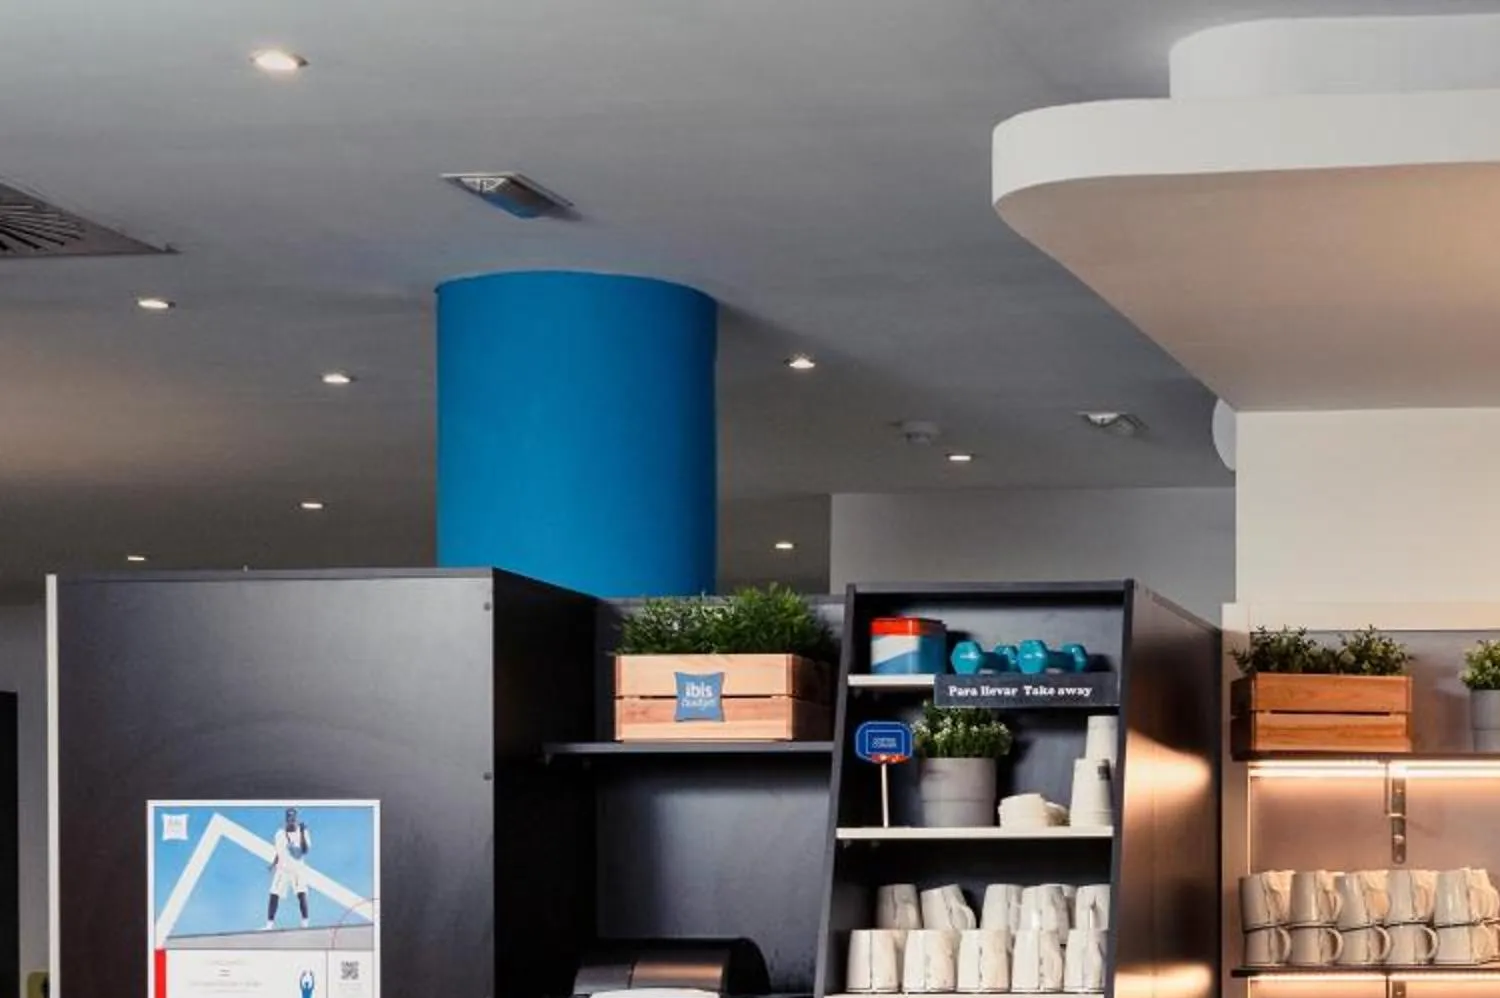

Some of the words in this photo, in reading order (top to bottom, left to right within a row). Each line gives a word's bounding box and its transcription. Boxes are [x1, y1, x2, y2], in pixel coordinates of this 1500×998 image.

[686, 681, 712, 698] ibis
[948, 685, 978, 697] Para
[980, 685, 1018, 697] llevar
[1024, 685, 1055, 697] Take
[1058, 686, 1093, 698] away
